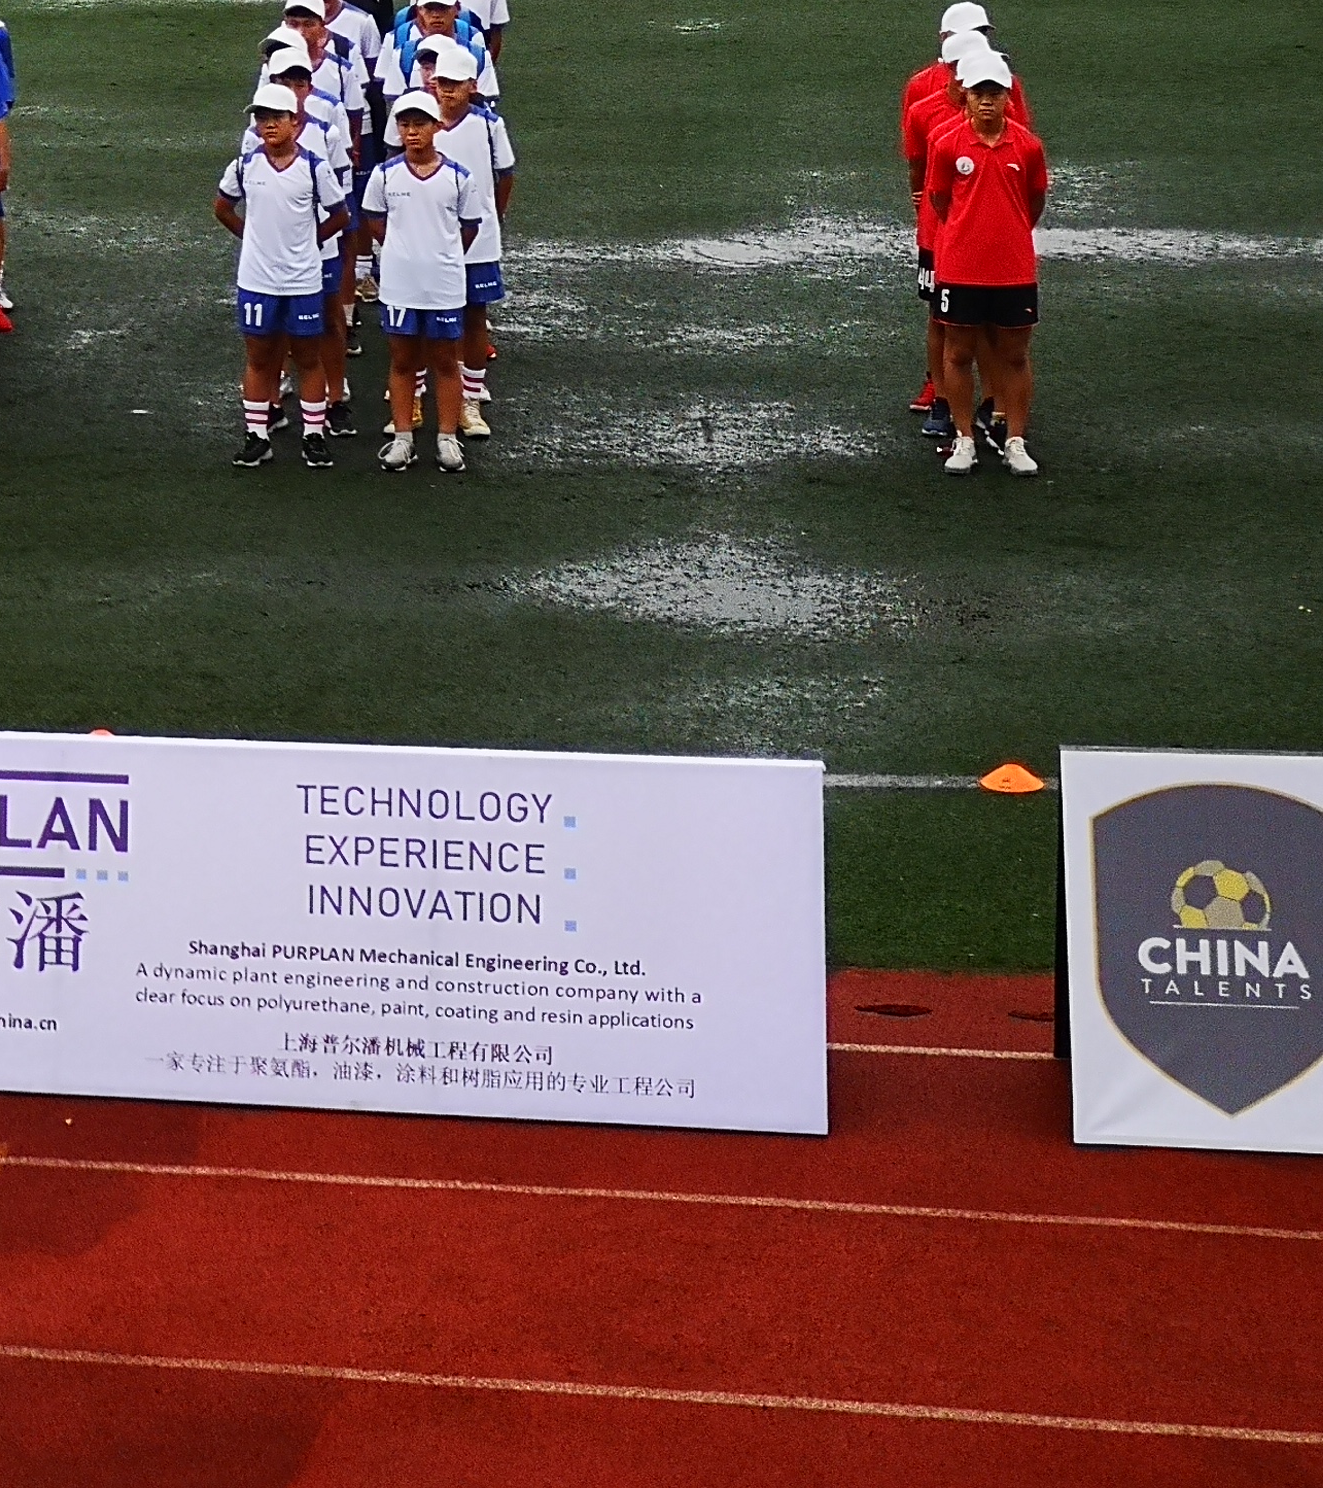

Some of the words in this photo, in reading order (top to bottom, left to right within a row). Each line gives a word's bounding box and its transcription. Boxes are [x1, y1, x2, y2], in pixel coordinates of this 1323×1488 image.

[244, 302, 263, 327] 11
[386, 305, 406, 328] 17
[940, 289, 950, 313] 5
[296, 784, 553, 824] TECHNOLOGY
[305, 834, 546, 874] EXPERIENCE
[307, 883, 542, 925] INNOVATION
[188, 940, 266, 961] Shanghai
[272, 944, 355, 962] PURPLAN
[359, 947, 459, 968] Mechanical
[465, 953, 569, 977] Engineering
[574, 958, 608, 978] Co.,
[614, 960, 646, 977] Ltd.
[1138, 936, 1311, 980] CHINA
[135, 963, 148, 977] A
[153, 962, 227, 984] dynamic
[232, 966, 278, 986] plant
[284, 970, 391, 992] engineering
[395, 975, 430, 991] and
[435, 978, 549, 997] construction
[555, 983, 639, 1005] company
[645, 988, 686, 1004] with
[691, 992, 702, 1004] a
[1141, 978, 1312, 1001] TALENTS
[135, 987, 176, 1004] clear
[181, 989, 225, 1006] focus
[230, 996, 252, 1008] on
[257, 995, 377, 1017] polyurethane,
[381, 1001, 430, 1018] paint,
[435, 1005, 499, 1024] coating
[503, 1006, 536, 1022] and
[541, 1010, 583, 1024] resin
[588, 1011, 695, 1030] applications
[277, 1032, 553, 1066] 上海普尔潘机械工程有限公司
